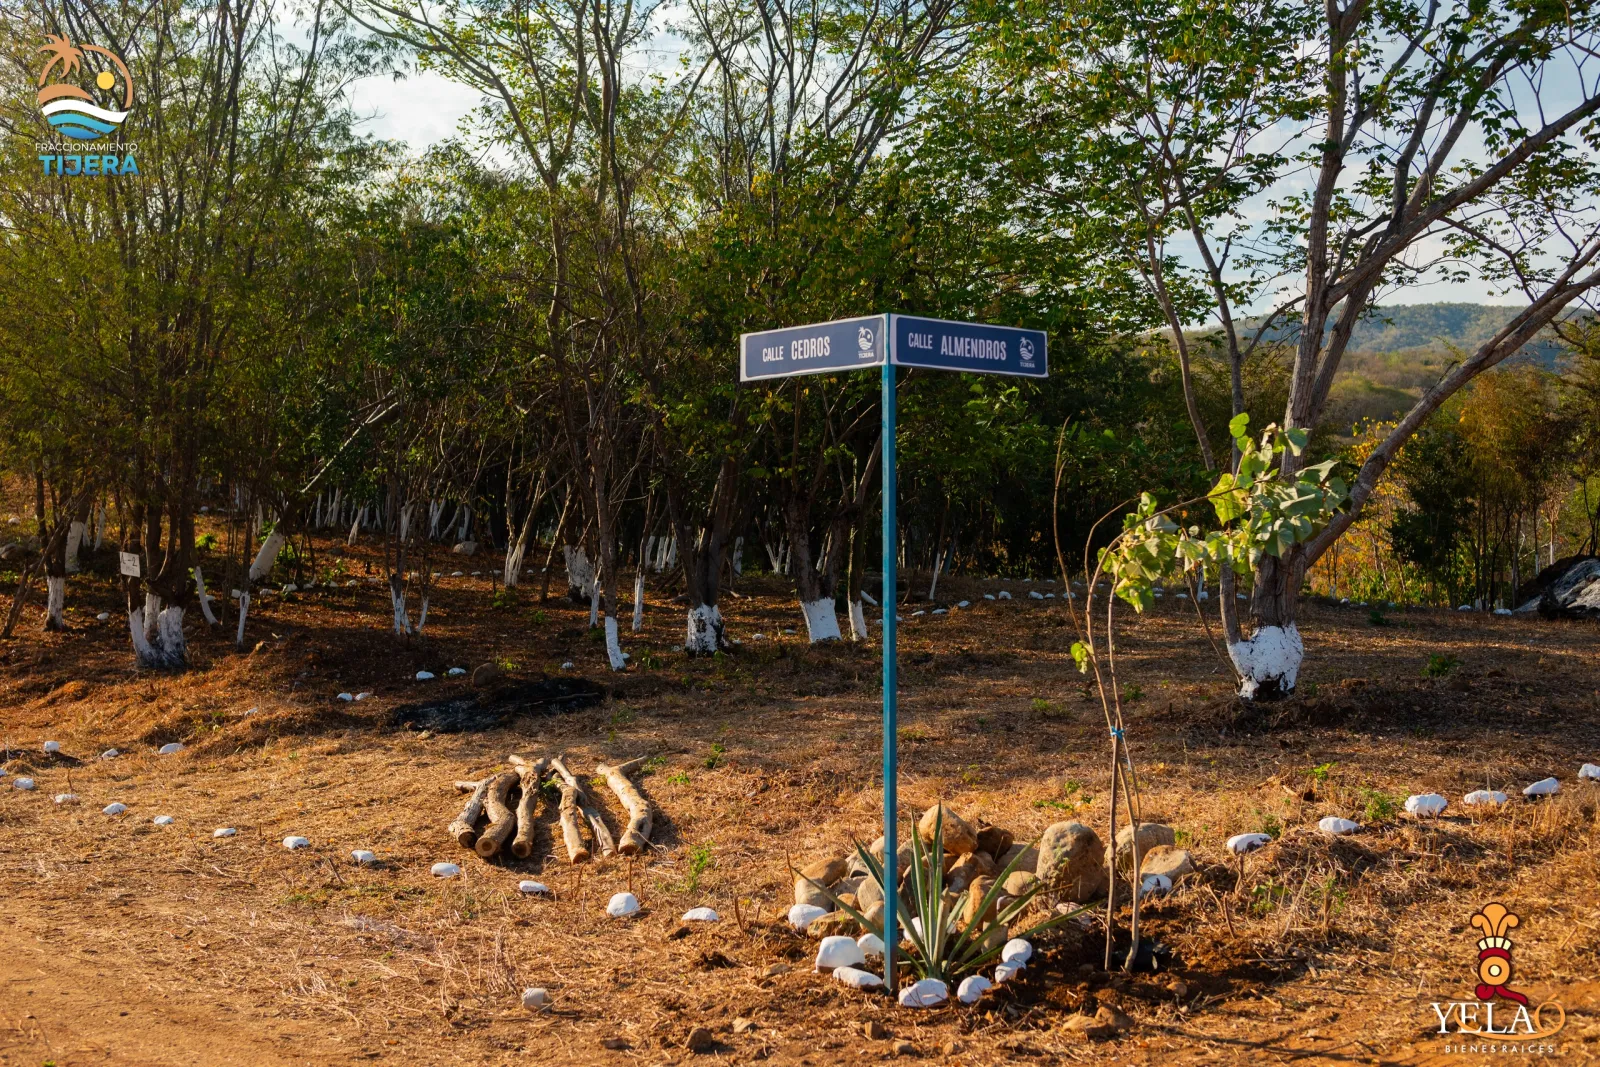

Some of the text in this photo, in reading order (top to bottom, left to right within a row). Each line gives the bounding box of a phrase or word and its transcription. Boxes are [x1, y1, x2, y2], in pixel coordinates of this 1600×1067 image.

[762, 336, 831, 362] CALLE CEDROS
[908, 332, 1007, 361] CALLE ALMENDROS
